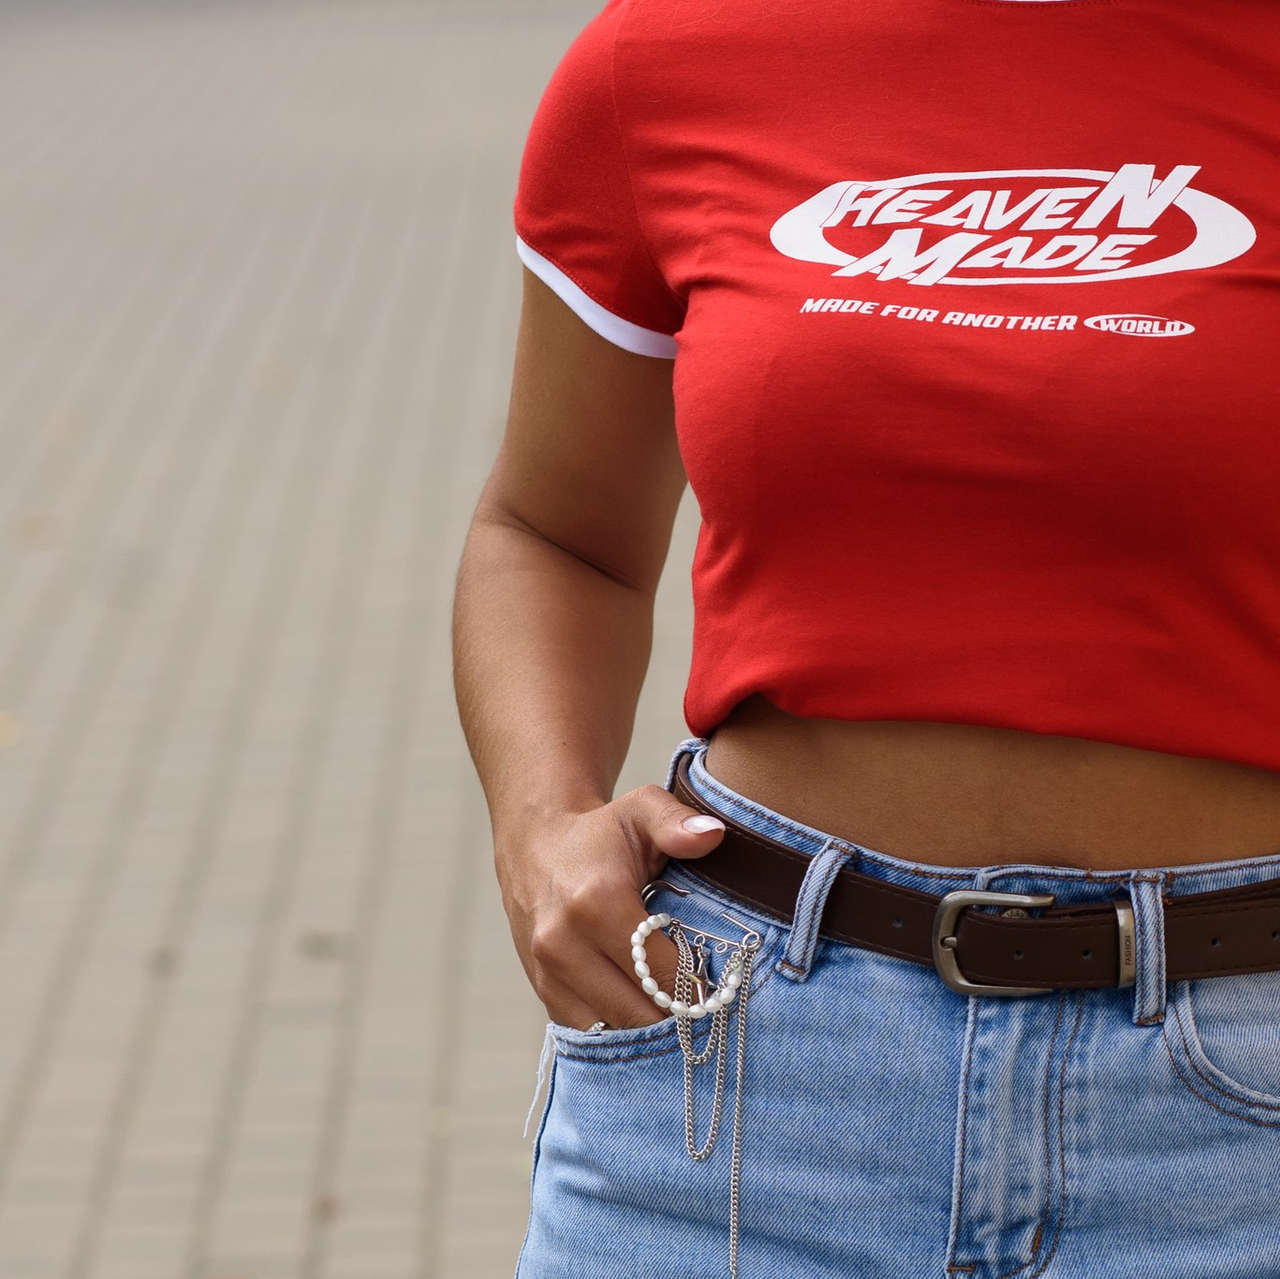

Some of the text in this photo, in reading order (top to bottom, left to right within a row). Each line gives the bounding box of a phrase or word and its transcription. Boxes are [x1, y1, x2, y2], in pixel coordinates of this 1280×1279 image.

[822, 163, 1201, 229] HEAVEN
[831, 228, 1157, 286] MADE
[800, 298, 1183, 334] MADE FOR ANOTHER WORLD
[1124, 935, 1132, 966] FASHION
